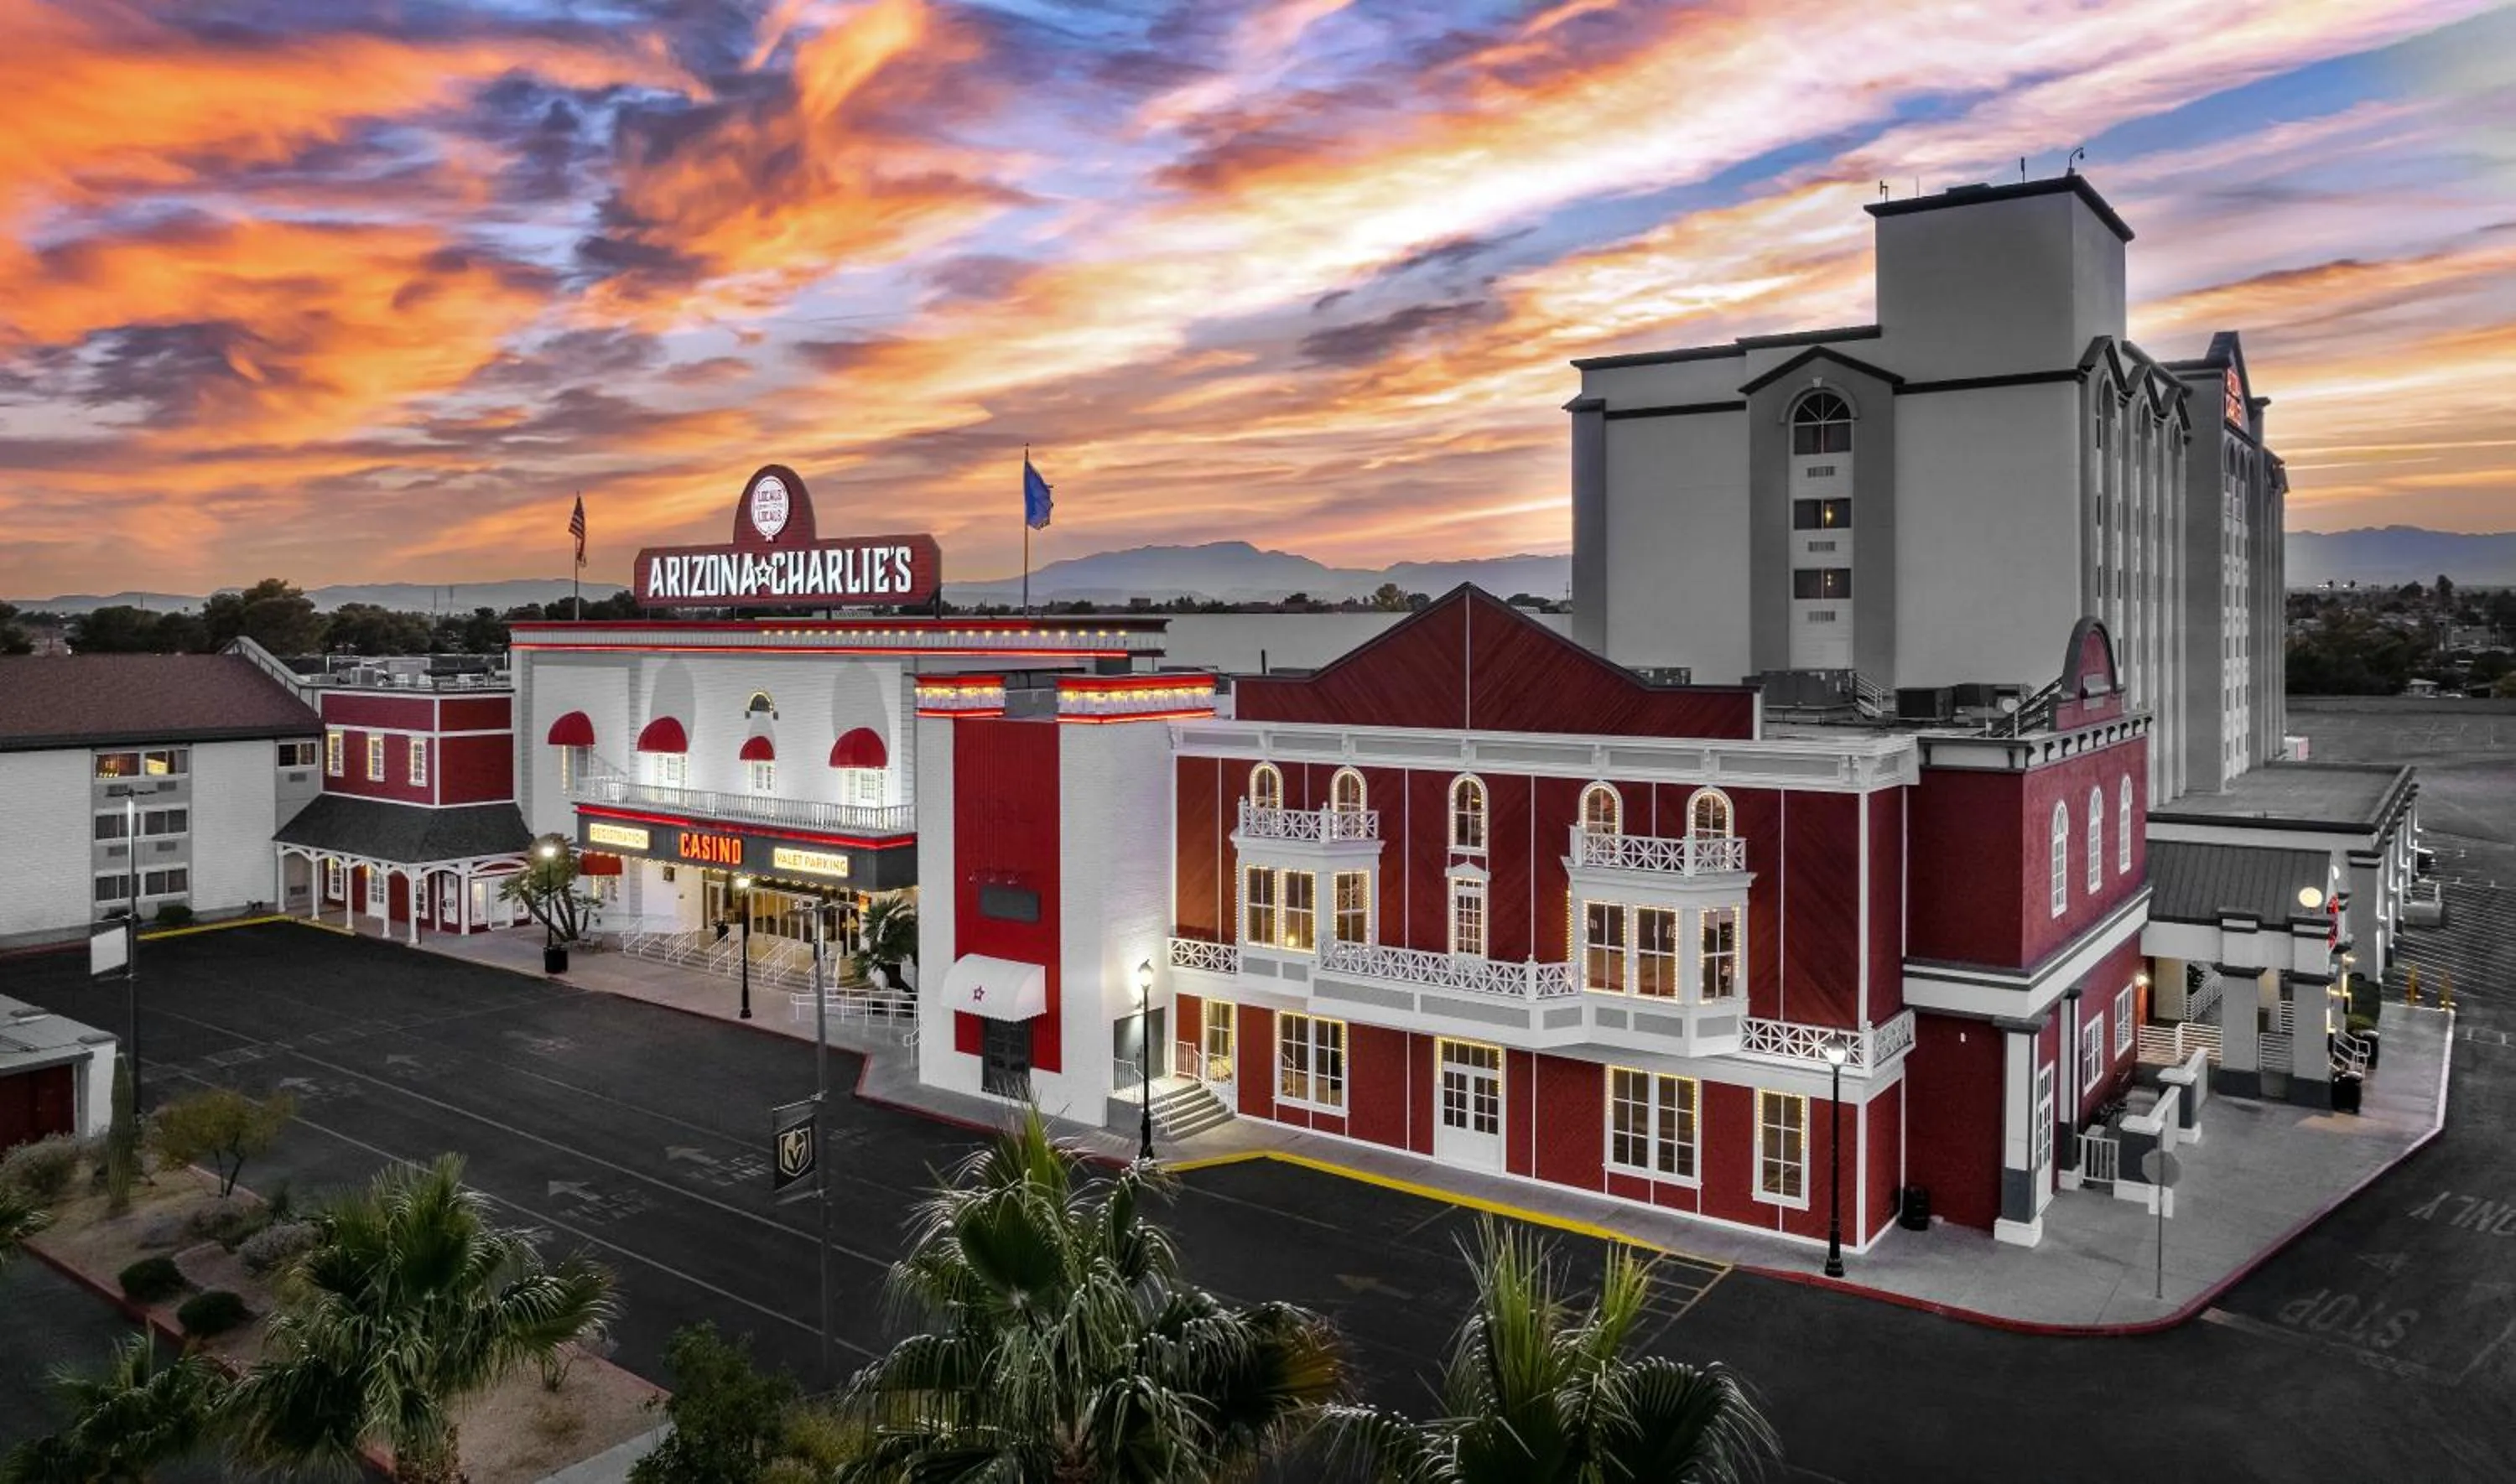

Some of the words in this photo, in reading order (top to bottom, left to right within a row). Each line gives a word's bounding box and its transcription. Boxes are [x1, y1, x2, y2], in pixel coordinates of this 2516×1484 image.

[647, 553, 756, 597] ARIZONA
[772, 547, 912, 596] CHARLIE'S
[591, 826, 647, 845] REGISTRATION
[680, 832, 741, 864] CASINO
[776, 850, 803, 866] VALET
[805, 854, 847, 873] PARKING
[2277, 1289, 2420, 1350] STOP
